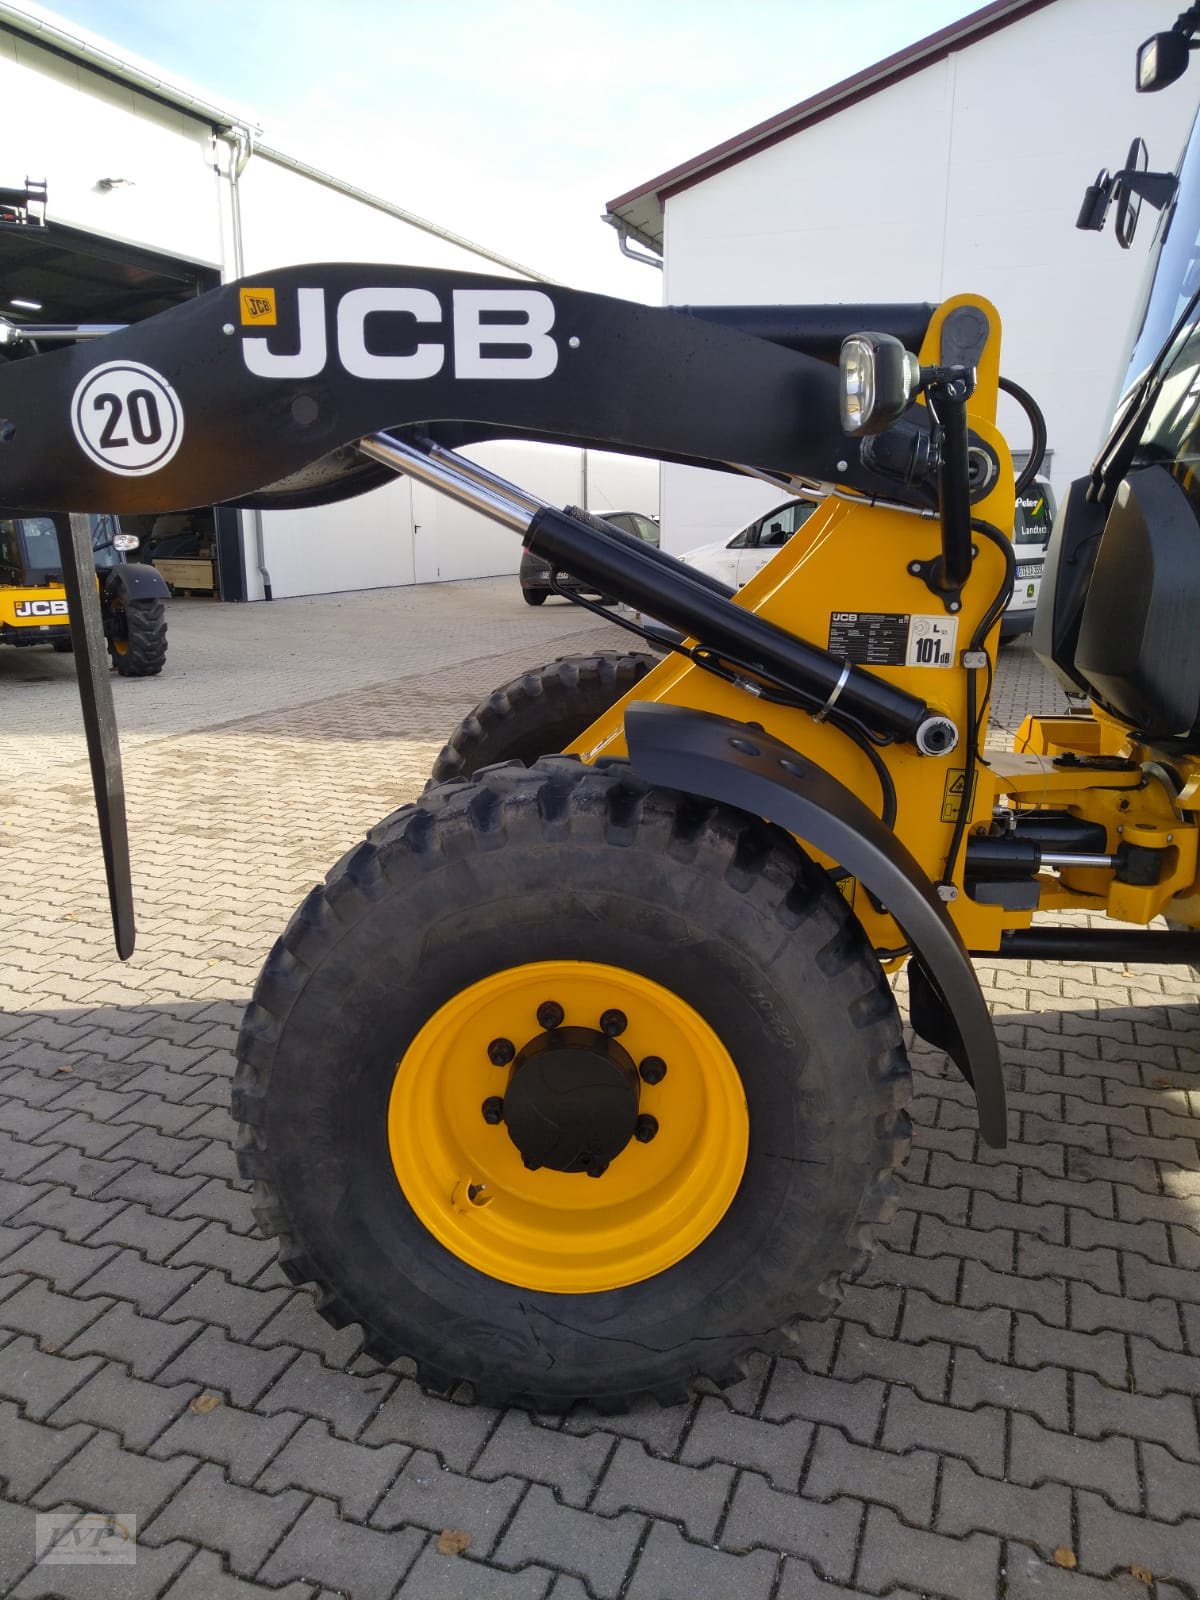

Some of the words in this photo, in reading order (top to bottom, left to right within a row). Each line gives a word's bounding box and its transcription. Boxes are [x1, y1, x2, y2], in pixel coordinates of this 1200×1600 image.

[249, 298, 270, 316] JCB
[242, 287, 559, 380] JCB
[93, 388, 162, 449] 20
[15, 601, 68, 616] JCB
[833, 613, 858, 622] JCB
[916, 638, 941, 663] 101
[940, 652, 951, 664] dB
